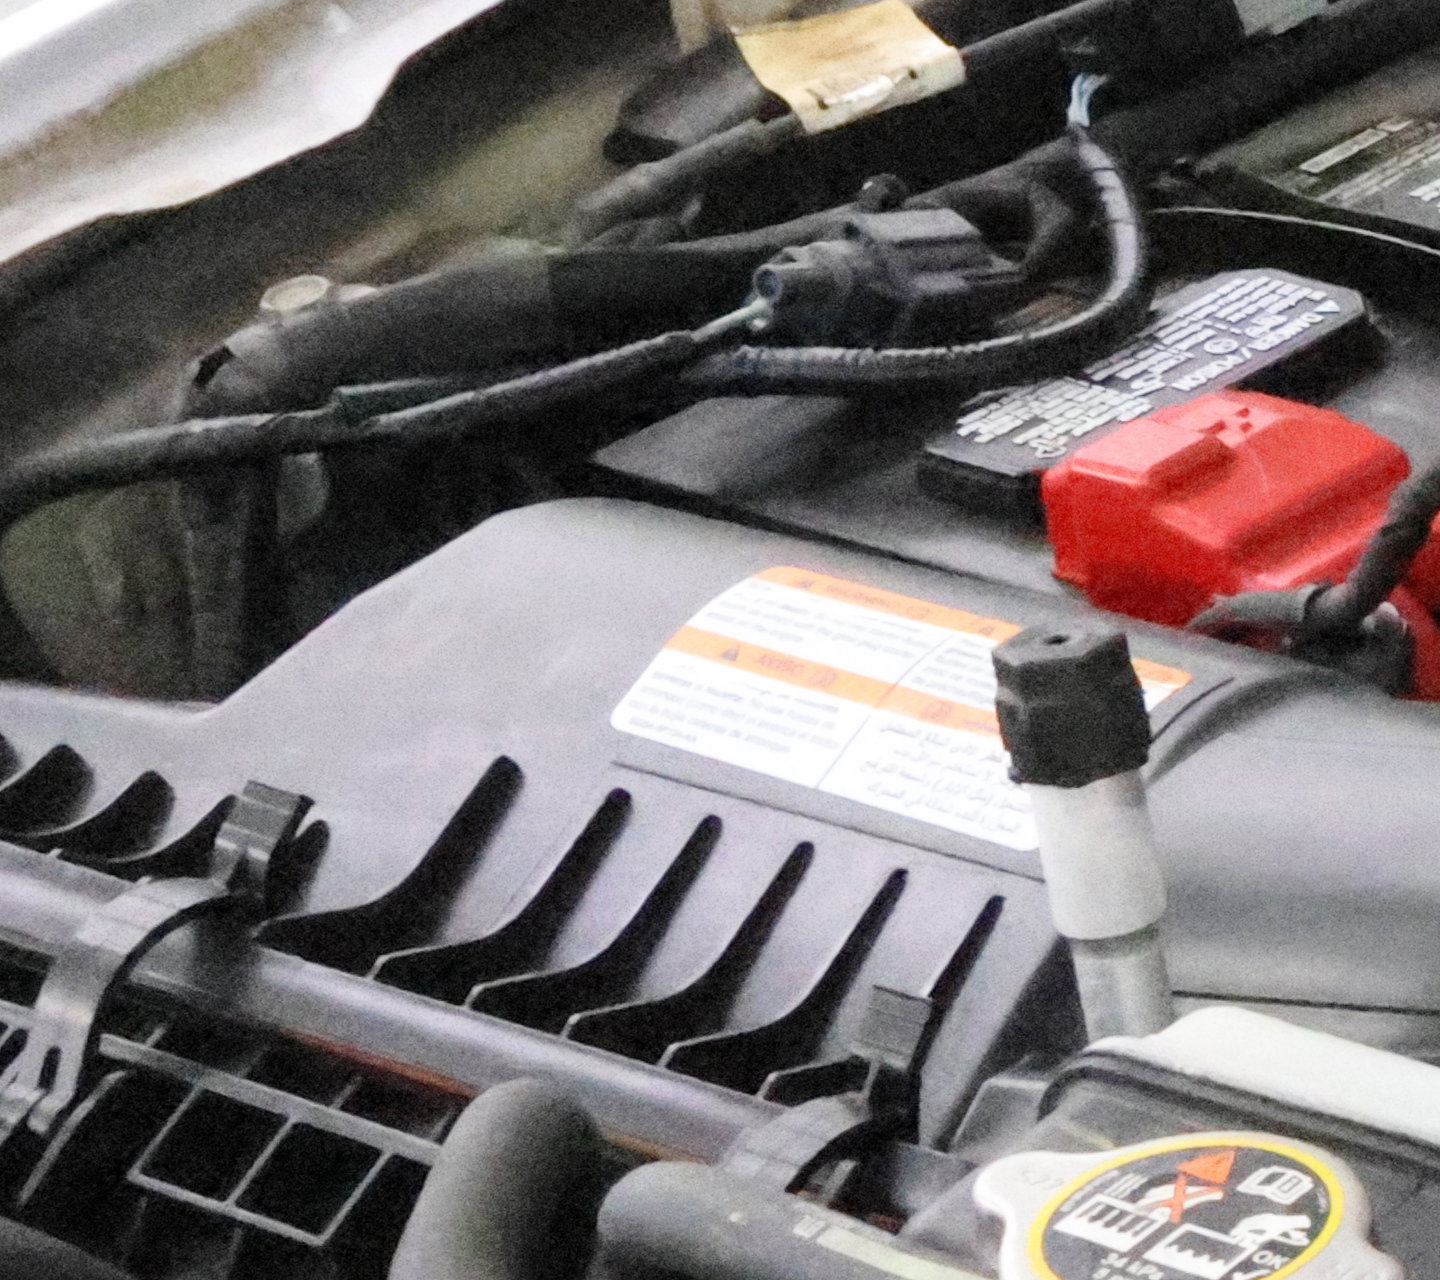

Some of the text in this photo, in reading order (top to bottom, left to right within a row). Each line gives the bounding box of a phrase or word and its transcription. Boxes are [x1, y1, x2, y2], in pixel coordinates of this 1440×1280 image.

[1247, 311, 1326, 351] DANGER
[1170, 353, 1246, 392] POISON
[1251, 1249, 1291, 1270] OK
